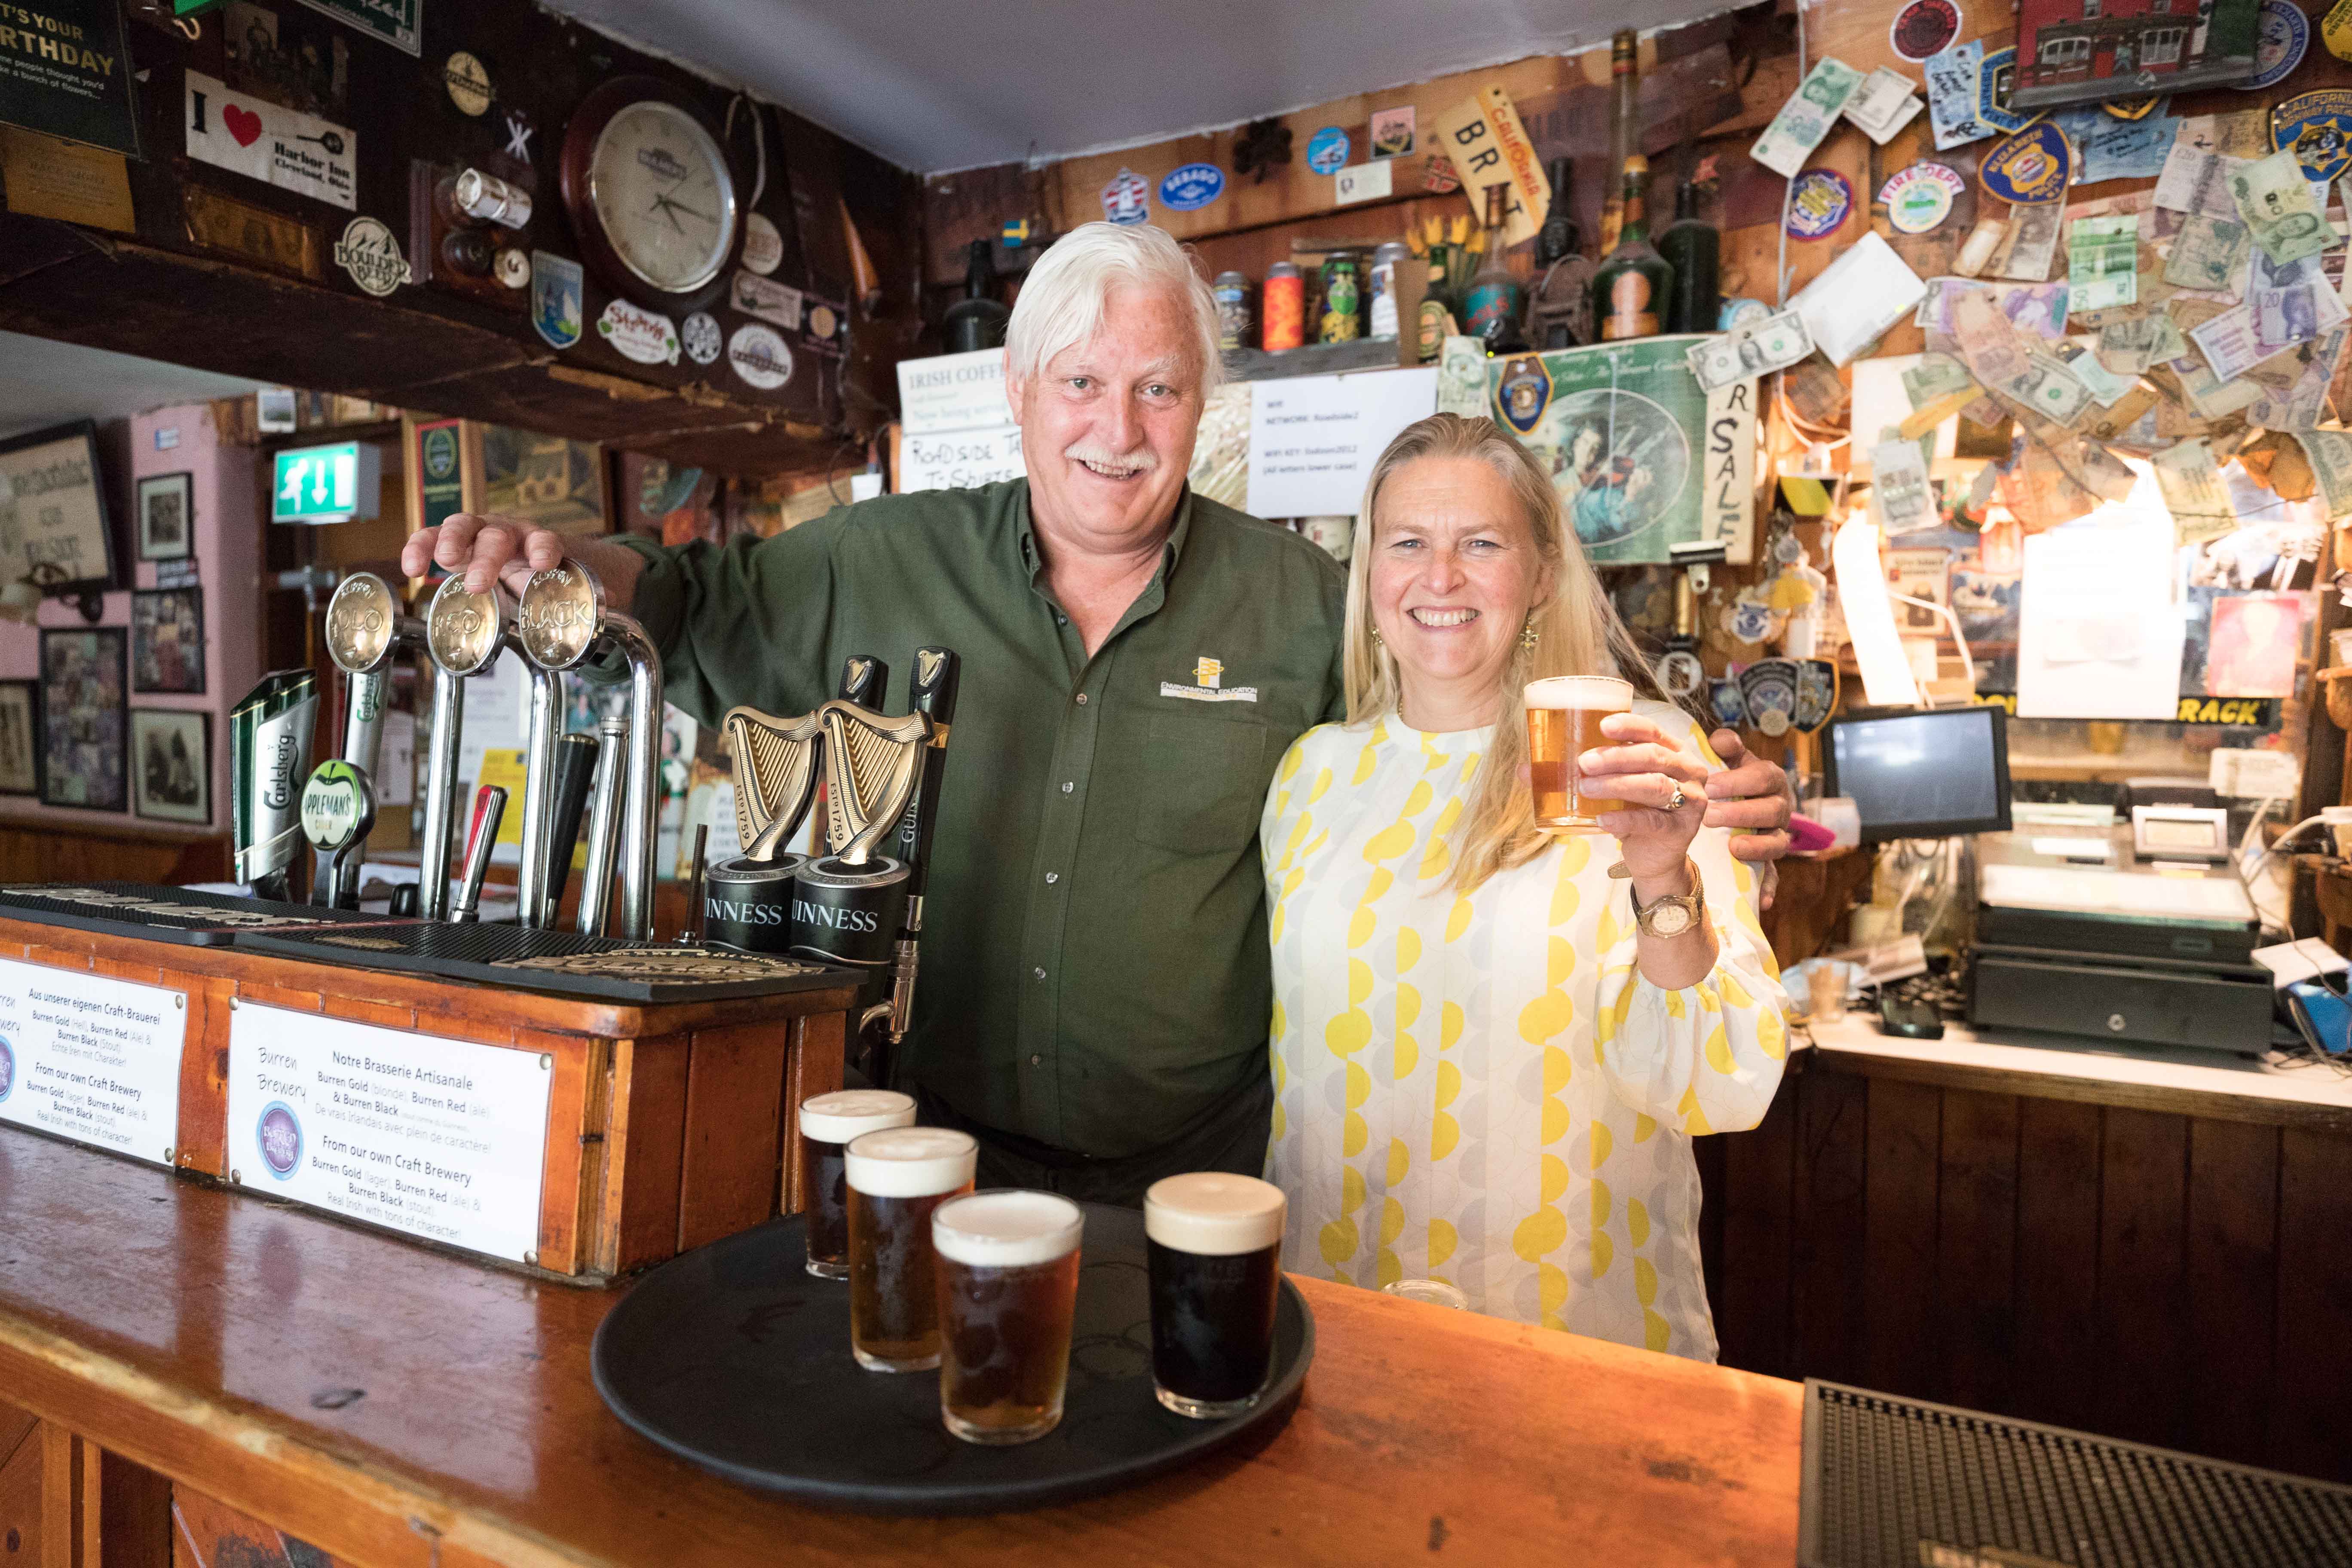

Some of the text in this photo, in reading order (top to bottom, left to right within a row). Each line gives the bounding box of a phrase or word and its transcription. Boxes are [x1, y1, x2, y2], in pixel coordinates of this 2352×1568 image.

[32, 13, 84, 40] YOUR
[192, 89, 208, 134] I
[274, 142, 350, 179] Harbor Inn
[1880, 168, 1915, 200] FIRE
[909, 368, 952, 389] IRISH
[521, 599, 593, 632] BLACK
[1161, 681, 1216, 695] ENVIRONMENTAL
[2179, 699, 2259, 725] RACK
[263, 734, 296, 810] Carlsberg
[738, 810, 750, 840] 1759
[832, 810, 844, 841] 1759
[28, 988, 161, 1026] Aus unserer eigenen Craft-Brauerei
[32, 1010, 53, 1023] Burren
[55, 1015, 69, 1027] Gold
[91, 1022, 113, 1035] Burren
[115, 1028, 128, 1039] Red
[129, 1031, 144, 1043] (Ale)
[145, 1034, 152, 1045] &
[58, 1029, 79, 1043] Burren
[81, 1034, 98, 1047] Black
[52, 1041, 68, 1054] Echte
[83, 1049, 93, 1060] mit
[258, 1047, 297, 1070] Burren
[36, 1062, 142, 1102] From our own Craft Brewery
[333, 1050, 473, 1090] Notre Brasserie Artisanale
[27, 1080, 48, 1094] Burren
[49, 1086, 64, 1098] Gold
[87, 1096, 110, 1110] Burren
[112, 1102, 125, 1115] Red
[257, 1073, 306, 1104] Brewery
[318, 1071, 346, 1087] Burren
[349, 1078, 368, 1092] Gold
[412, 1091, 444, 1109] Burren
[447, 1099, 466, 1112] Red
[334, 1091, 399, 1116] & Burren Black
[37, 1109, 49, 1121] Real
[51, 1113, 64, 1125] Irish
[65, 1119, 77, 1130] with
[79, 1123, 92, 1135] tons
[94, 1127, 101, 1137] of
[54, 1101, 74, 1115] Burren
[76, 1107, 93, 1121] Black
[315, 1103, 326, 1115] De
[328, 1108, 346, 1121] vrais
[348, 1111, 382, 1130] Irlandais
[385, 1122, 403, 1135] avec
[407, 1125, 428, 1139] plein
[431, 1130, 442, 1143] de
[323, 1135, 472, 1188] From our own Craft Brewery
[312, 1156, 340, 1173] Burren
[342, 1165, 361, 1179] Gold
[395, 1179, 426, 1197] Burren
[429, 1188, 447, 1202] Red
[473, 1198, 481, 1211] &
[349, 1182, 377, 1200] Burren
[380, 1191, 403, 1207] Black
[328, 1191, 344, 1206] Real
[346, 1196, 362, 1211] Irish
[365, 1203, 382, 1218] with
[385, 1210, 403, 1224] tons
[405, 1216, 415, 1227] of
